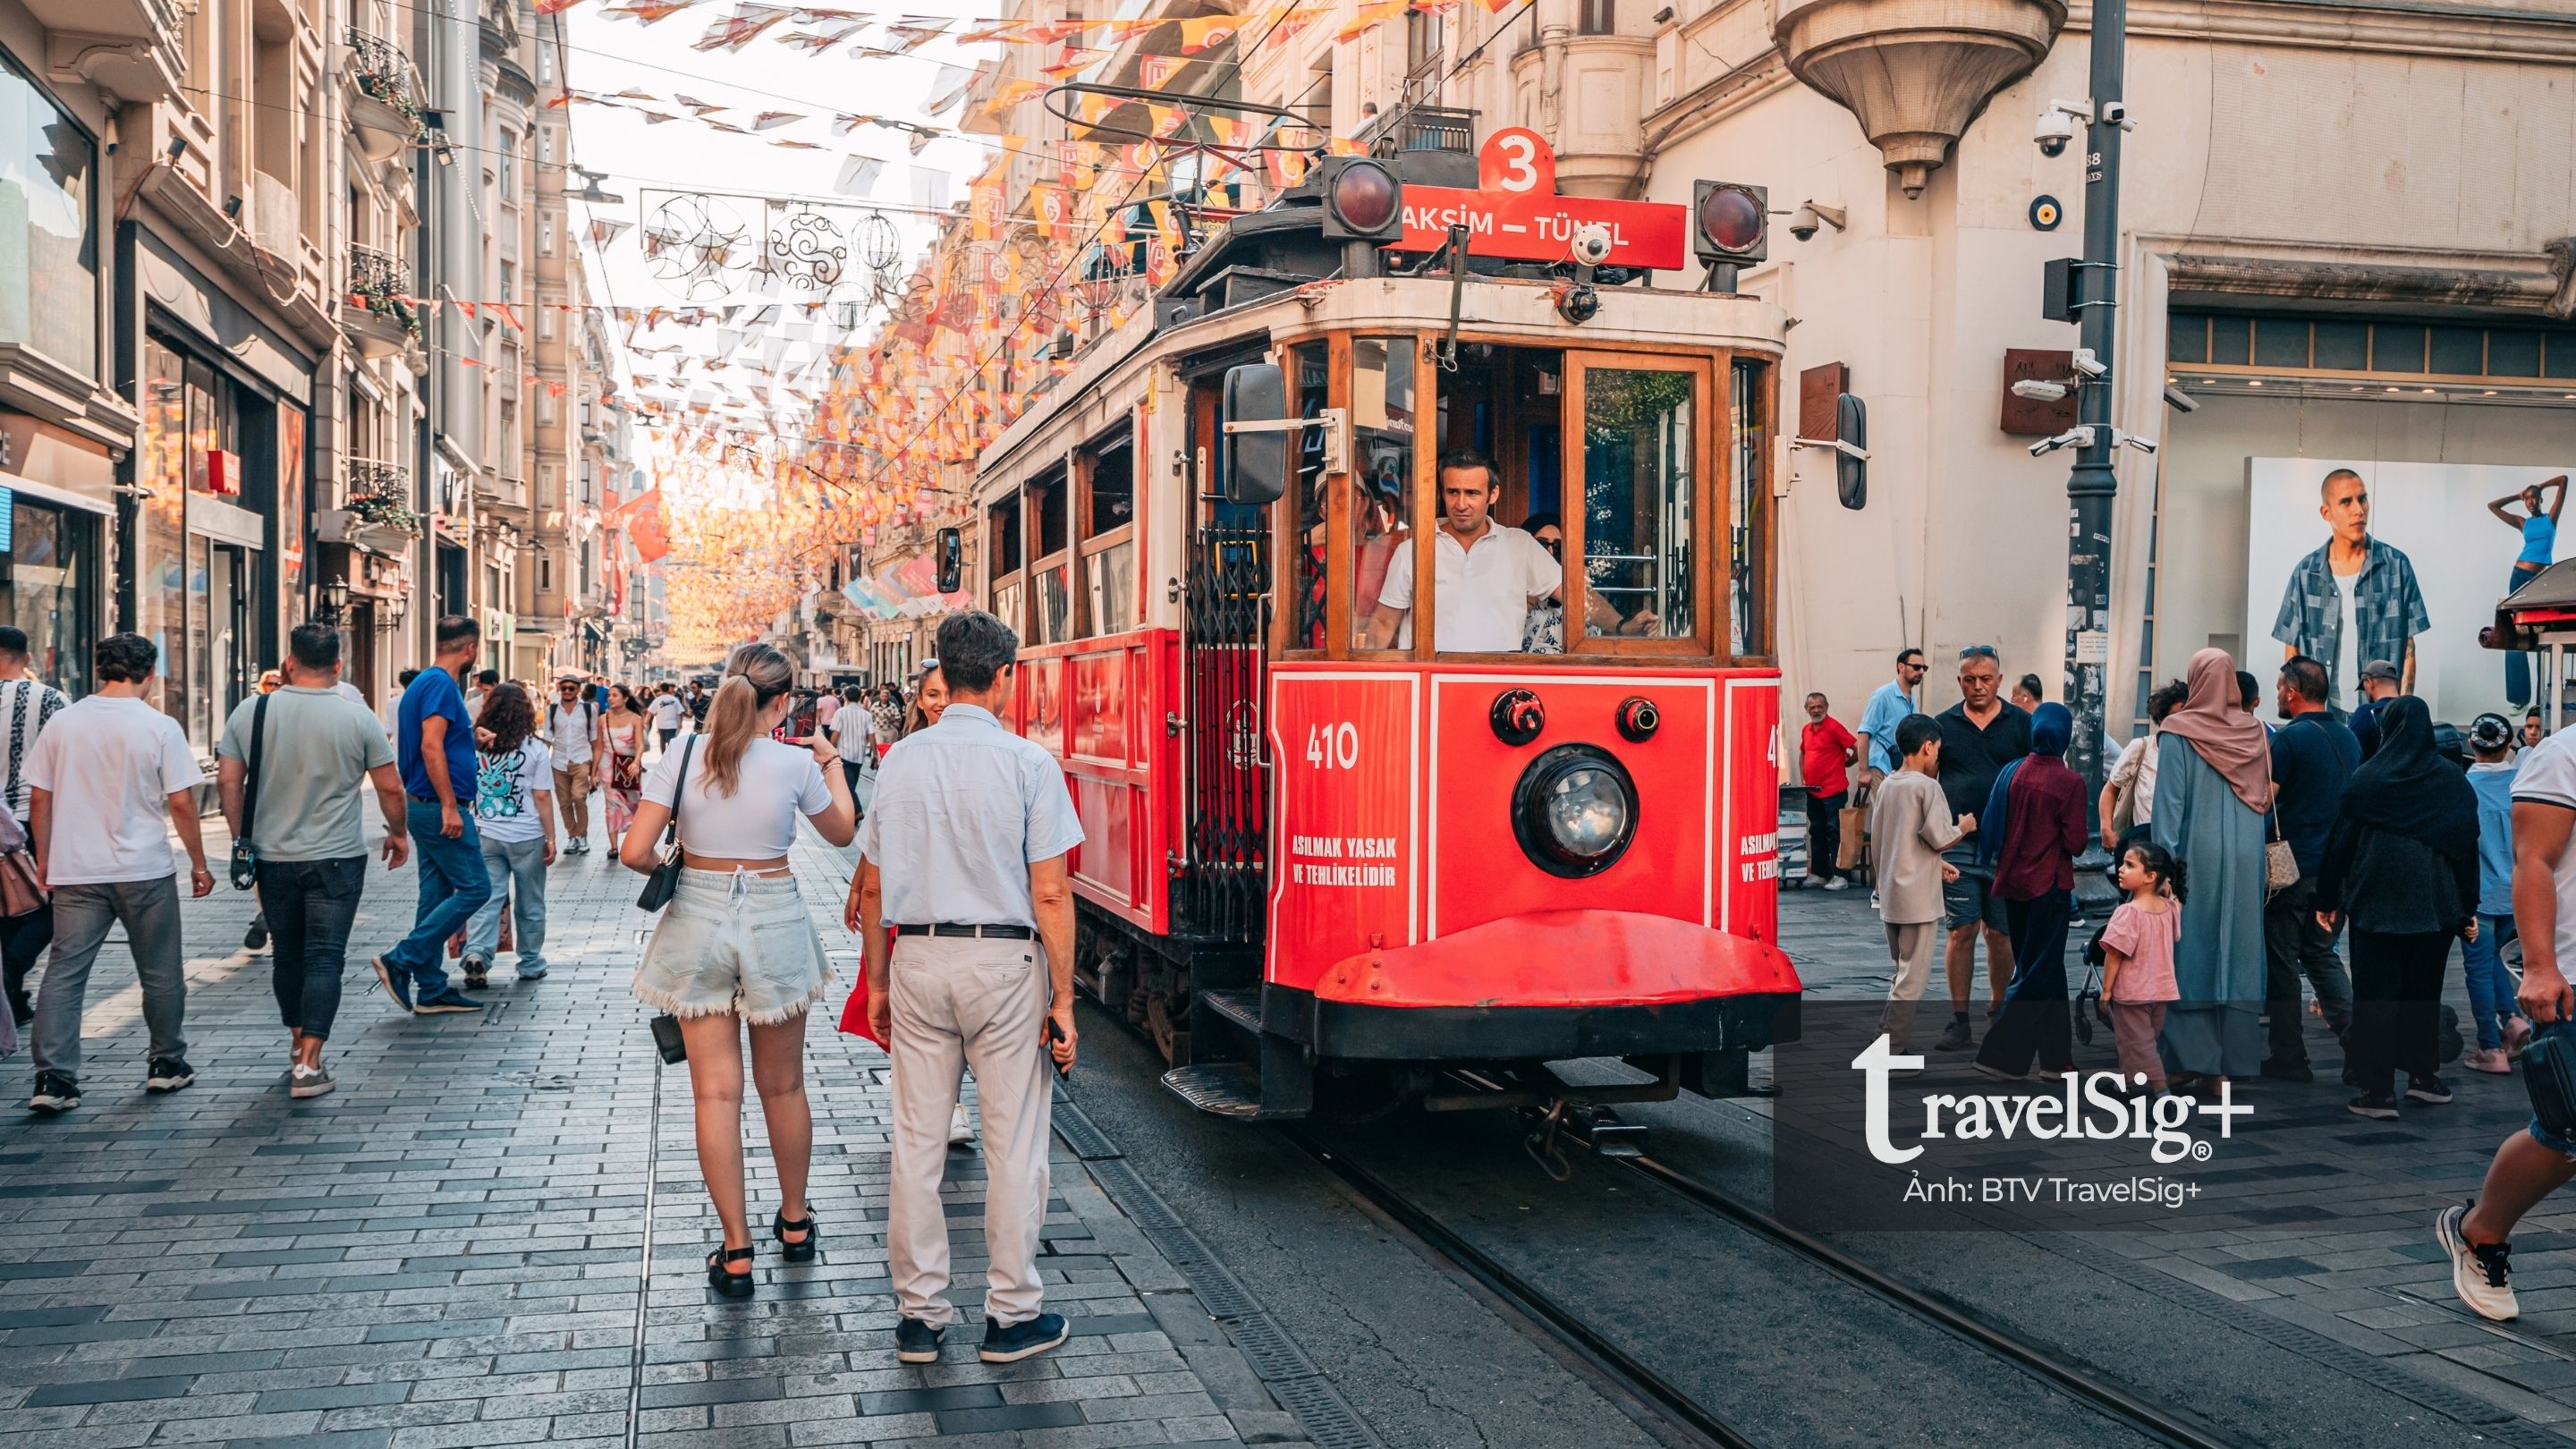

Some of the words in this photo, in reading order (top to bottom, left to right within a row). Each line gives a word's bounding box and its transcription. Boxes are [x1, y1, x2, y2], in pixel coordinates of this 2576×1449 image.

[1499, 135, 1538, 192] 3
[1402, 204, 1493, 235] AKSİM
[1307, 721, 1359, 769] 410
[1767, 724, 1779, 768] 4
[1292, 835, 1343, 858] ASILMAK
[1346, 837, 1397, 859] YASAK
[1293, 863, 1303, 884] VE
[1306, 862, 1396, 886] TEHLİKELİDİR
[1741, 862, 1755, 883] VE
